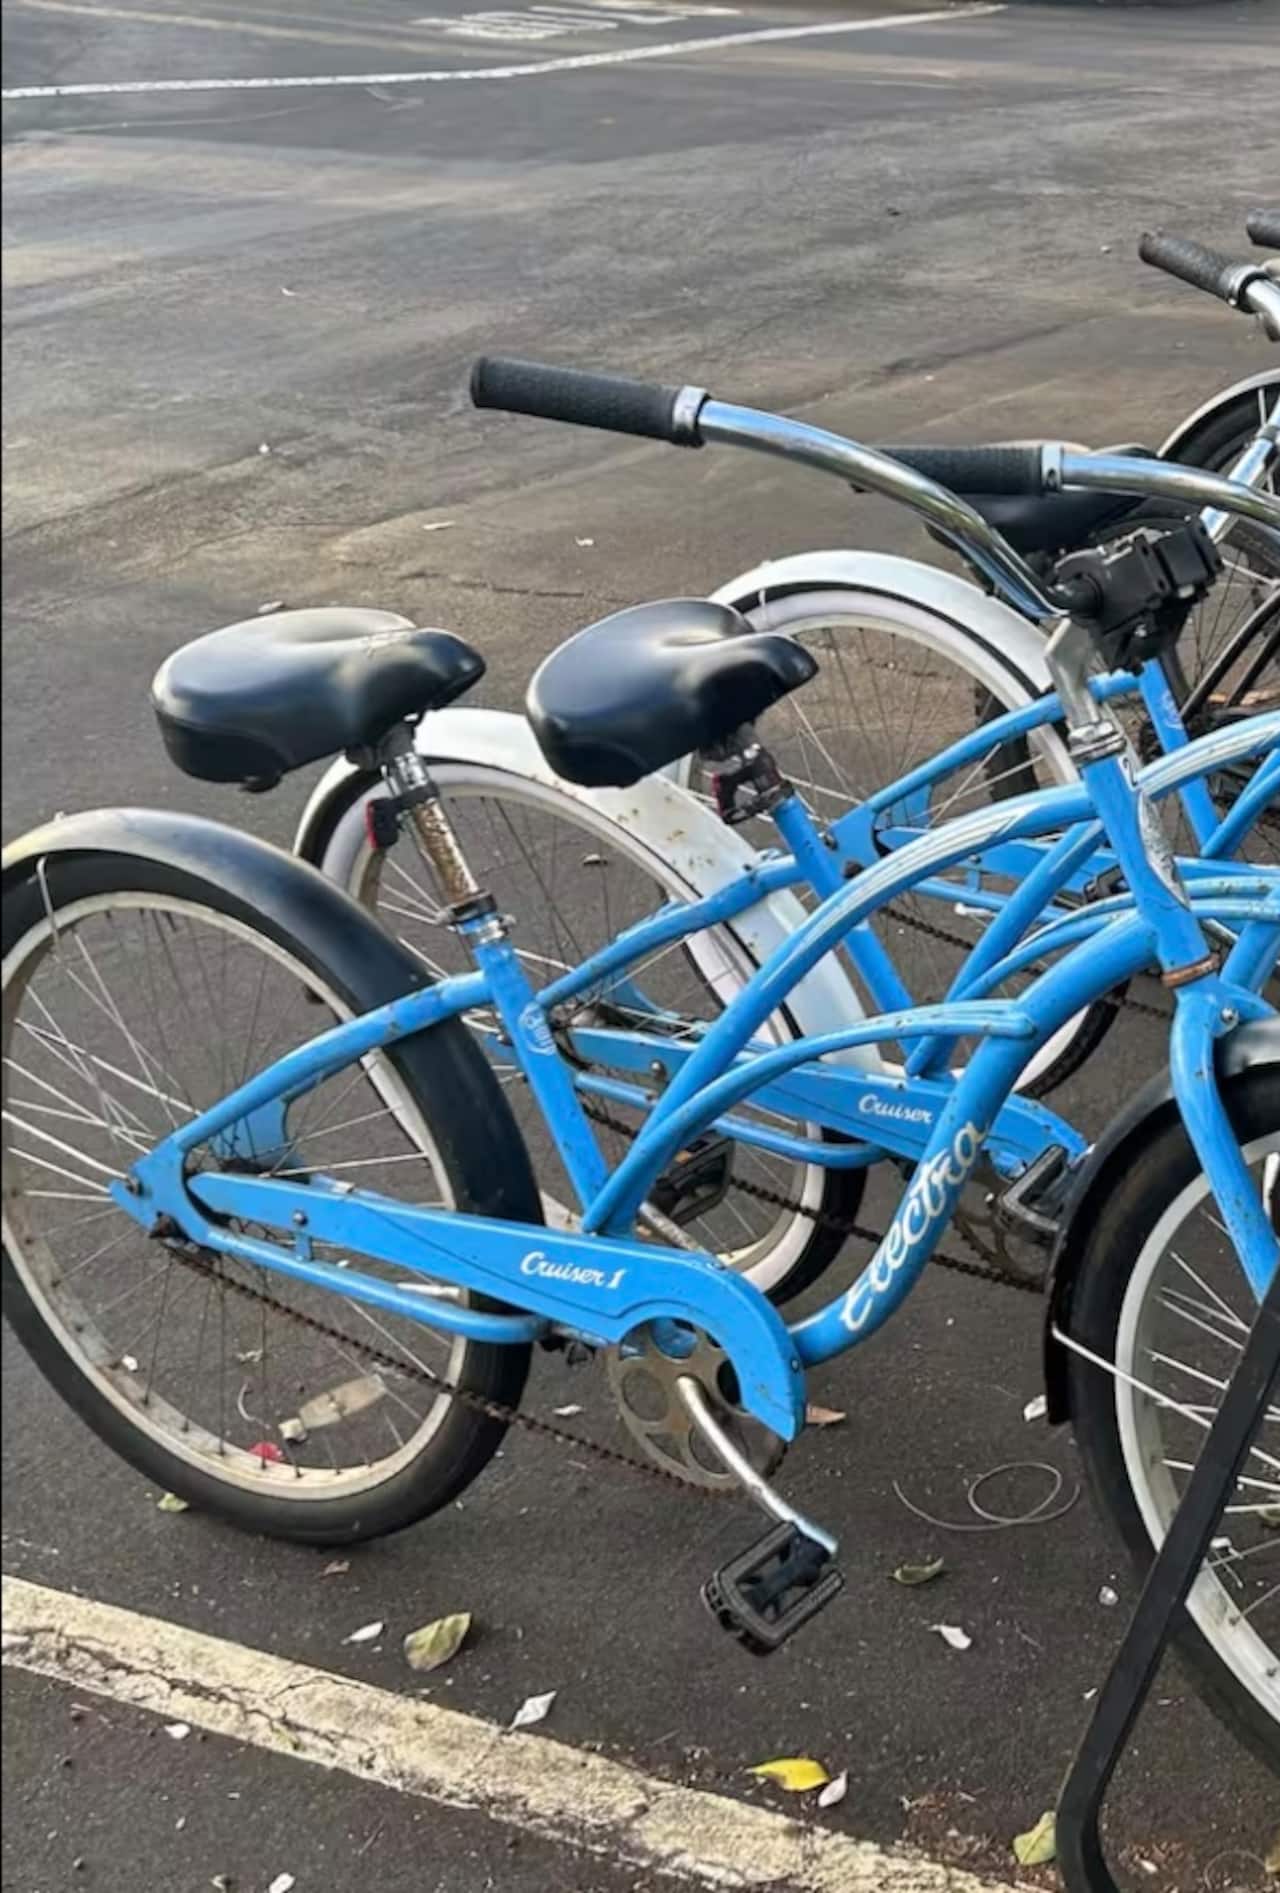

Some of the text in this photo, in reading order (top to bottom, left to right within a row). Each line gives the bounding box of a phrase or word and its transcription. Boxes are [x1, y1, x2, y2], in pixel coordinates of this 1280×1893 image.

[858, 1093, 934, 1125] Cruiser
[840, 1120, 989, 1332] Electra
[519, 1250, 627, 1290] Cruiser 1
